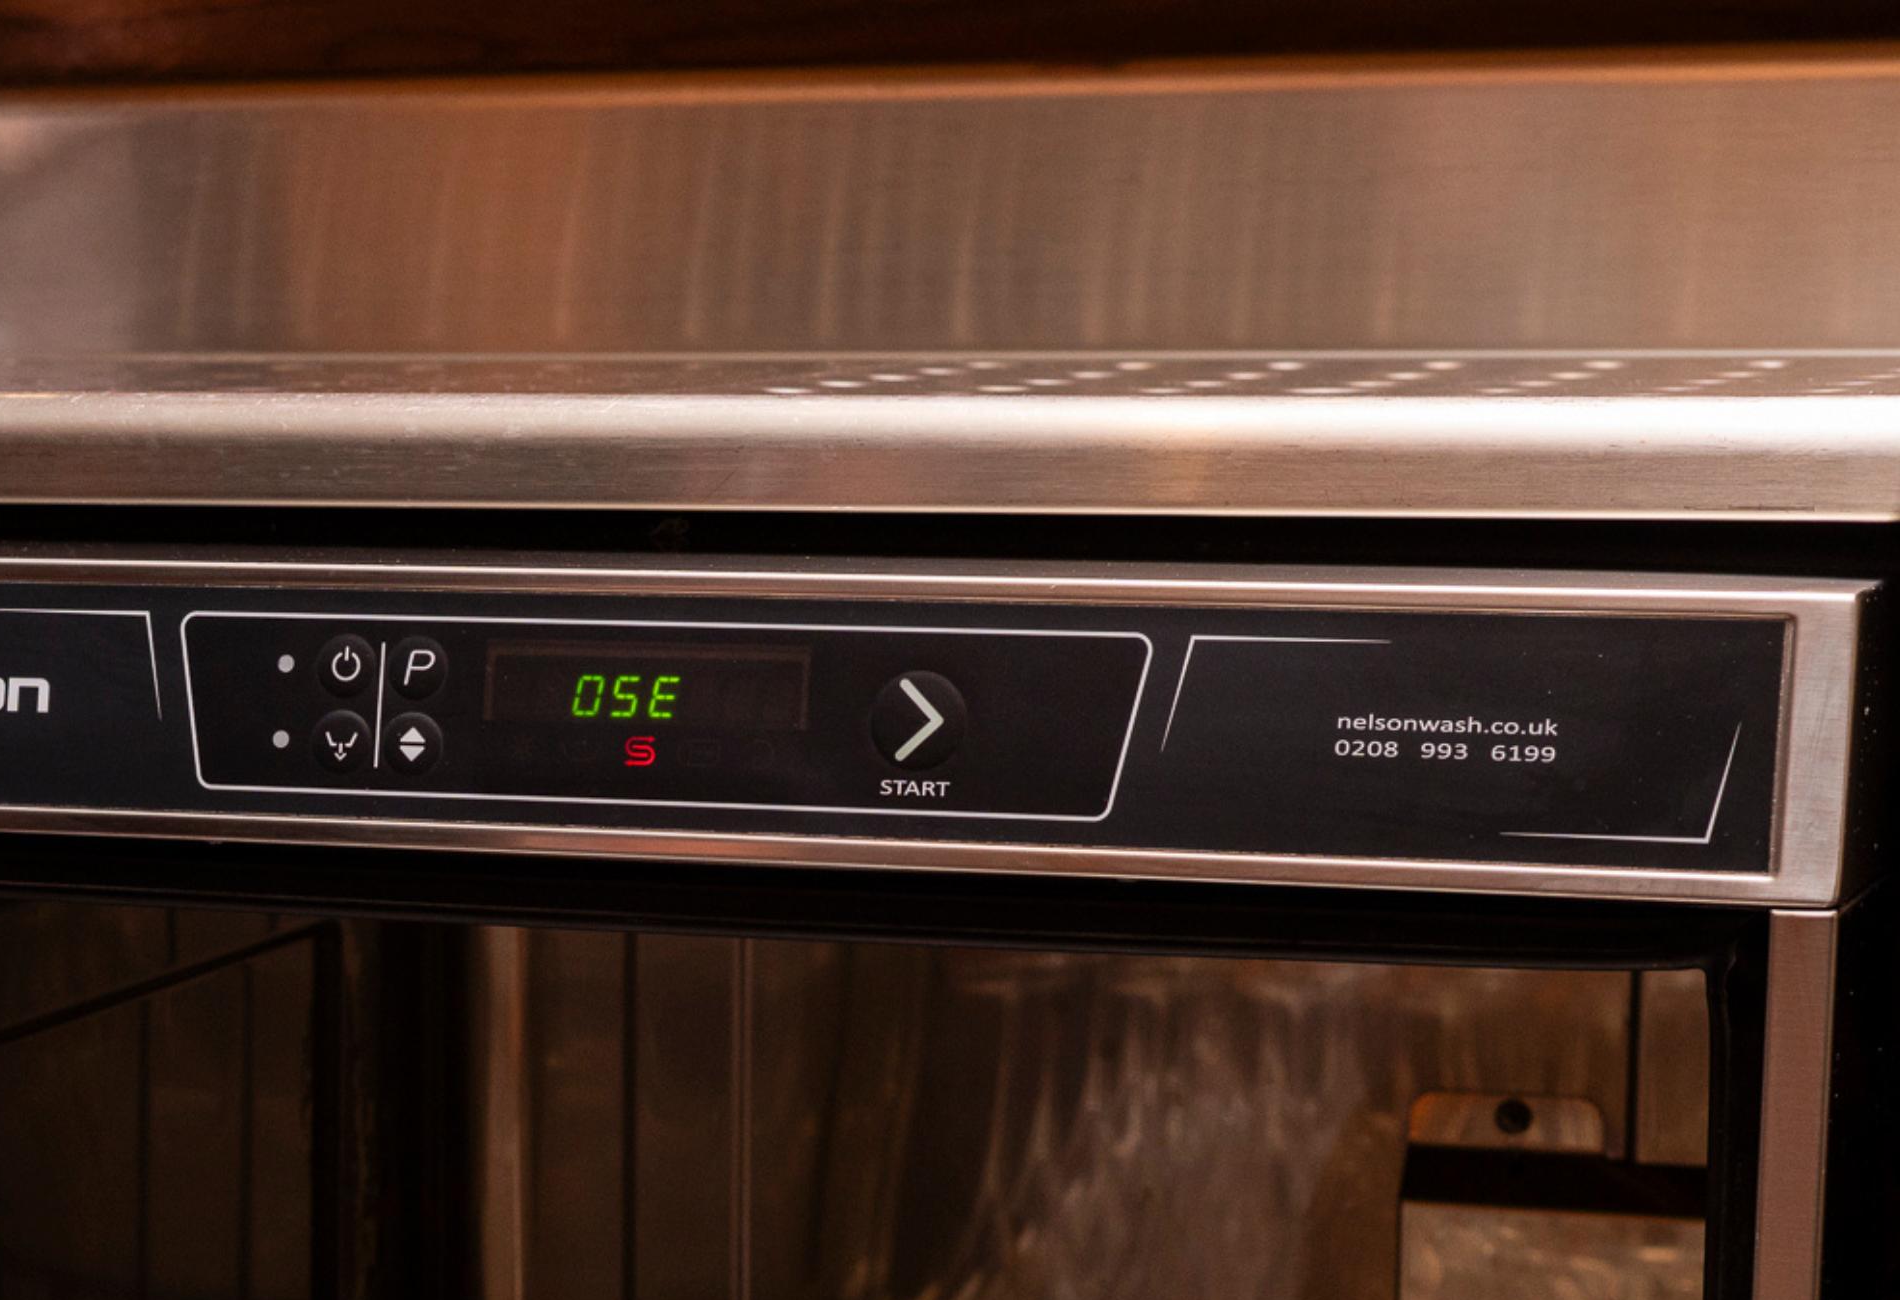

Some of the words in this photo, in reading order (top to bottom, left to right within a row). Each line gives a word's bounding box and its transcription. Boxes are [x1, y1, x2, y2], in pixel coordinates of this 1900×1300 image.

[403, 650, 436, 686] P
[1337, 713, 1558, 736] nelsonwash.co.uk
[1334, 740, 1399, 758] 0208
[1420, 743, 1468, 760] 993
[1491, 745, 1556, 763] 6199
[879, 779, 951, 797] START
